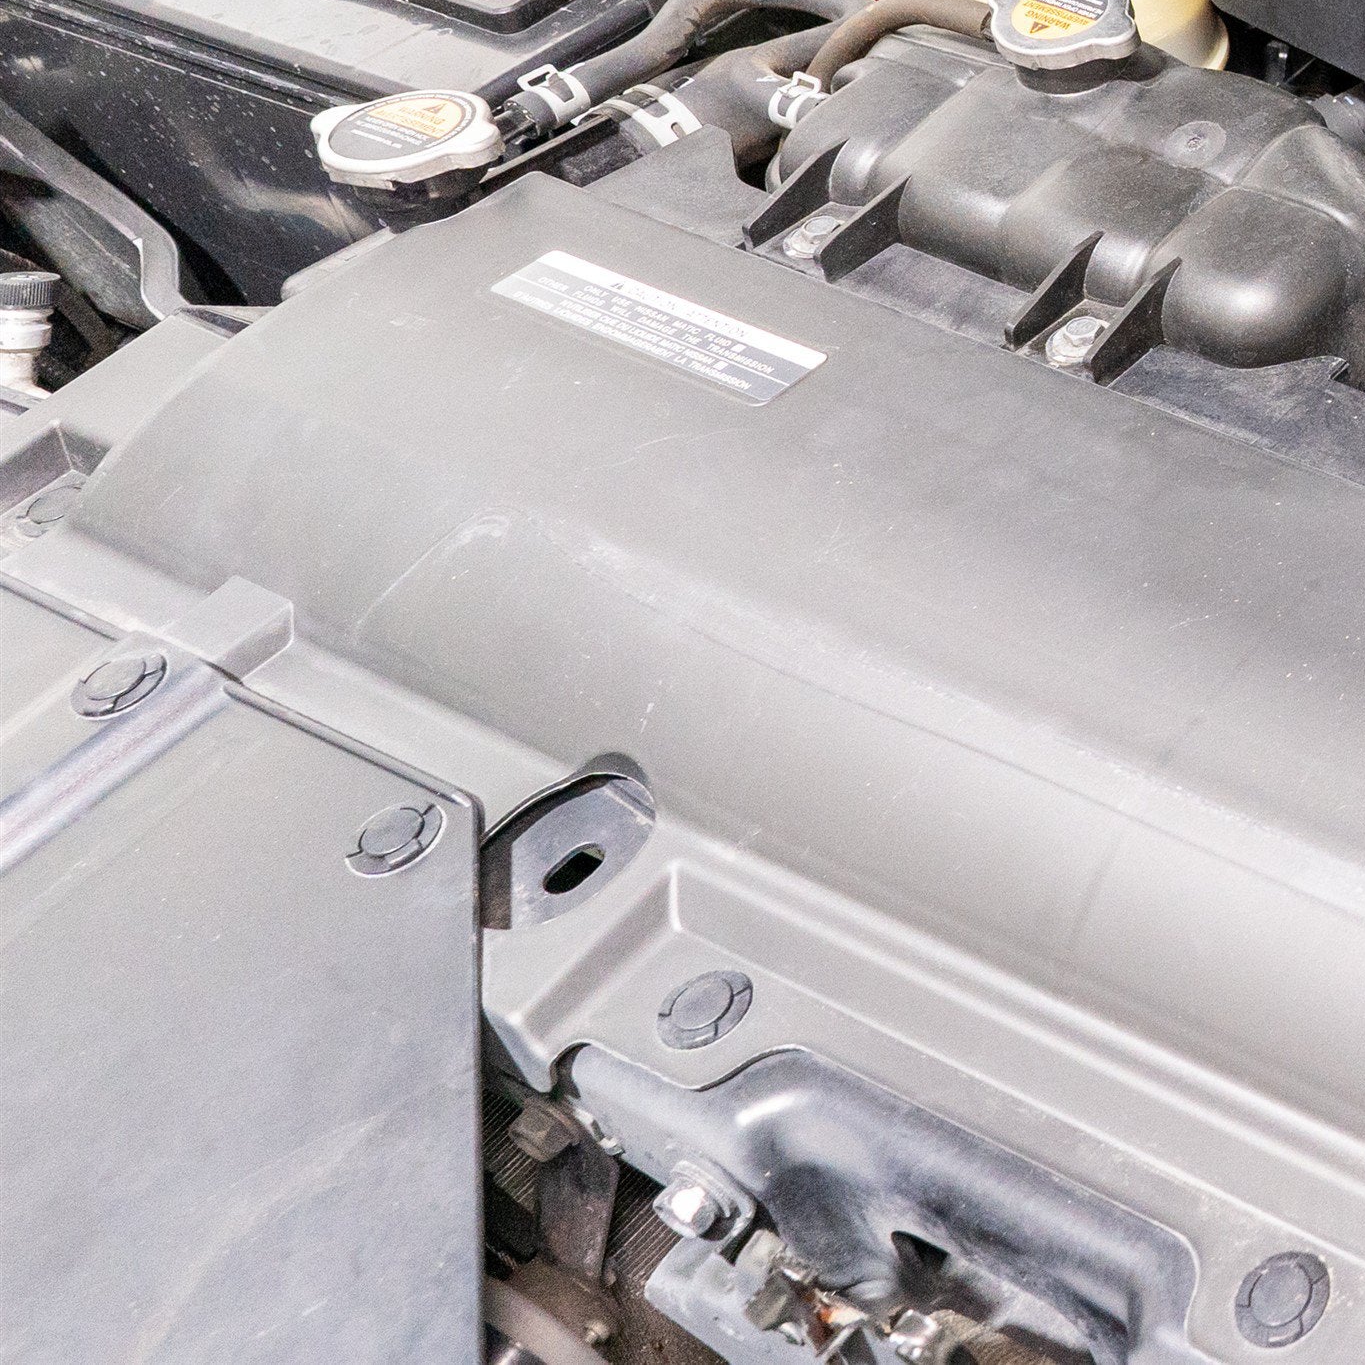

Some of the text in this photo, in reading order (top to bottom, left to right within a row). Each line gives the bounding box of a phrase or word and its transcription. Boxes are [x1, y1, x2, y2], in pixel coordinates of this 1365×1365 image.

[1025, 10, 1071, 30] WARNING
[538, 276, 775, 374] OTHER FLUIDS WILL DAMAGE THE TRANSMISSION
[583, 285, 733, 347] ONLY USE NISSAN MATIC FLUID
[686, 360, 752, 391] TRANSMISSION
